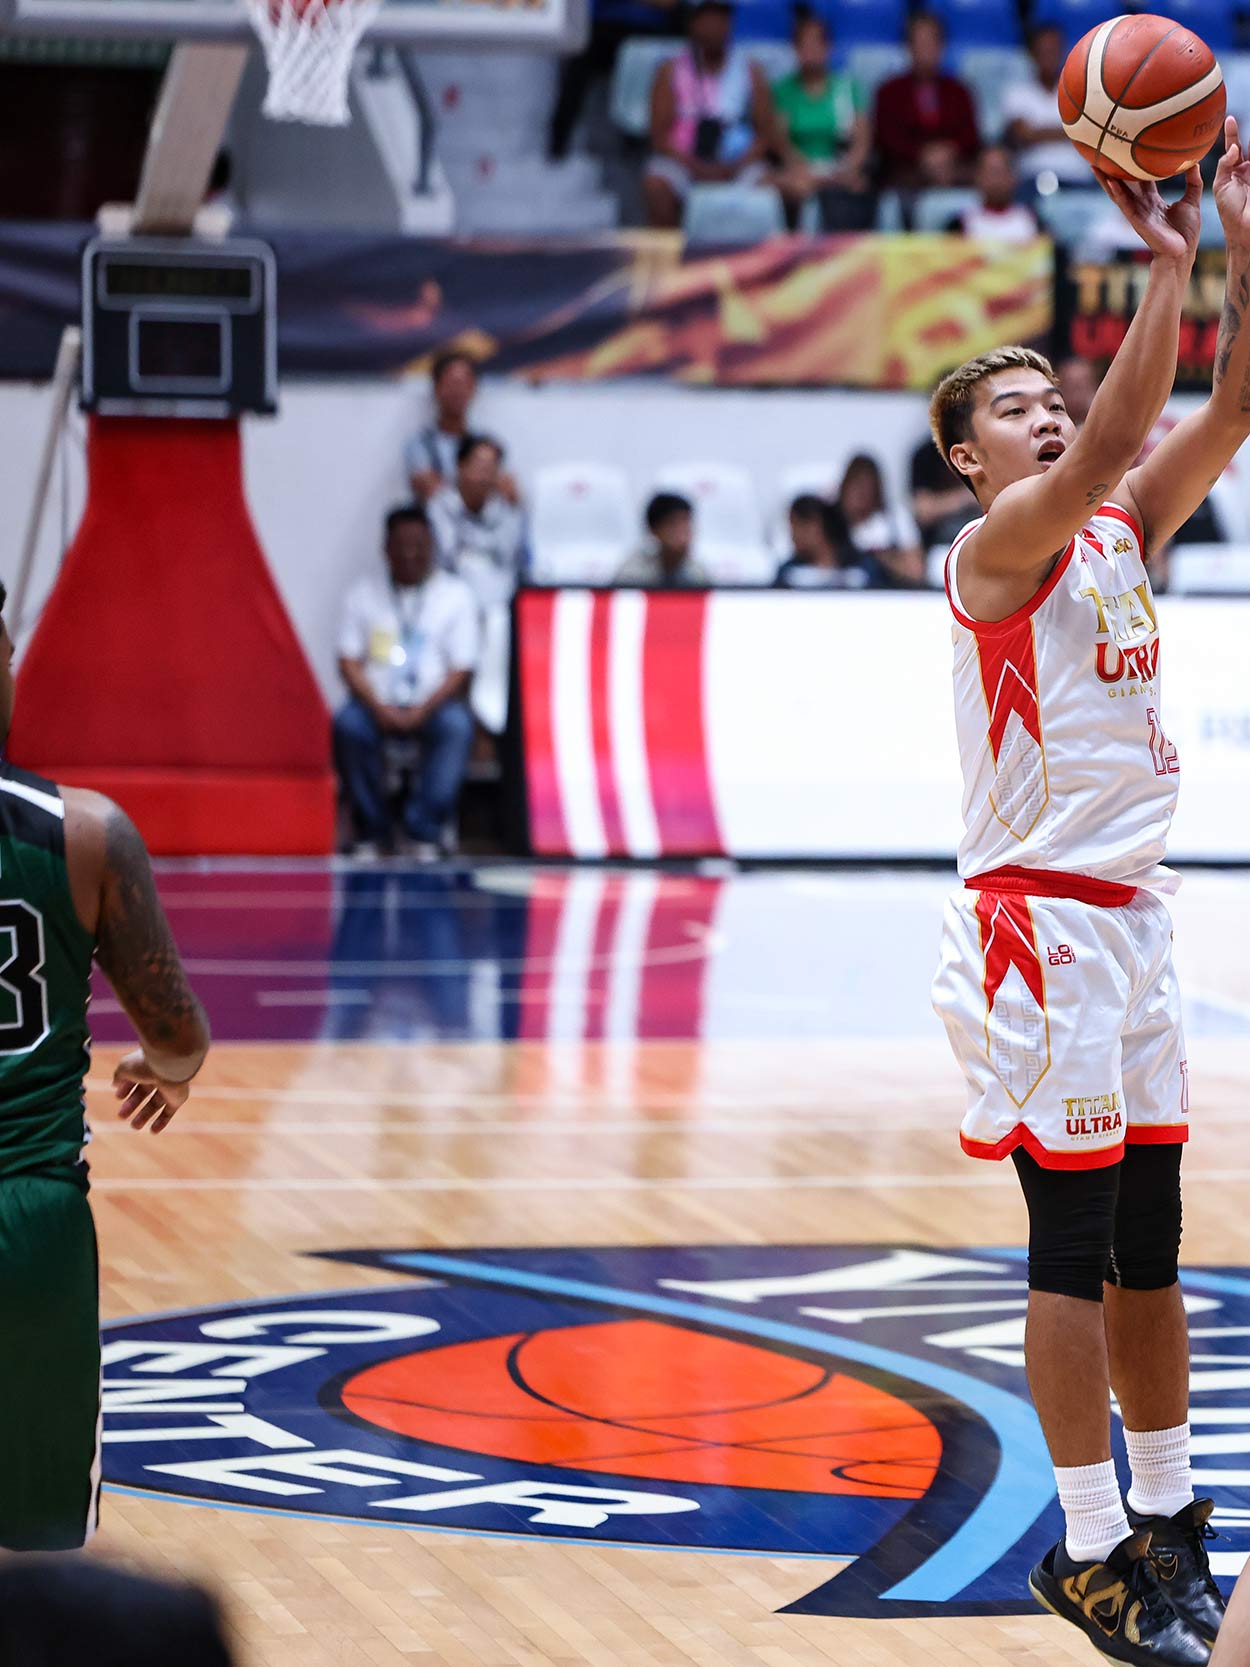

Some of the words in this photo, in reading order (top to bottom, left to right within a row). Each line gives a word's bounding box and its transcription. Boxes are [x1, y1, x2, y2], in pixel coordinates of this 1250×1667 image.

[1095, 637, 1159, 683] UTR
[1108, 685, 1147, 698] GIAN
[1065, 1112, 1122, 1136] ULTRA
[102, 1309, 701, 1529] CENTER
